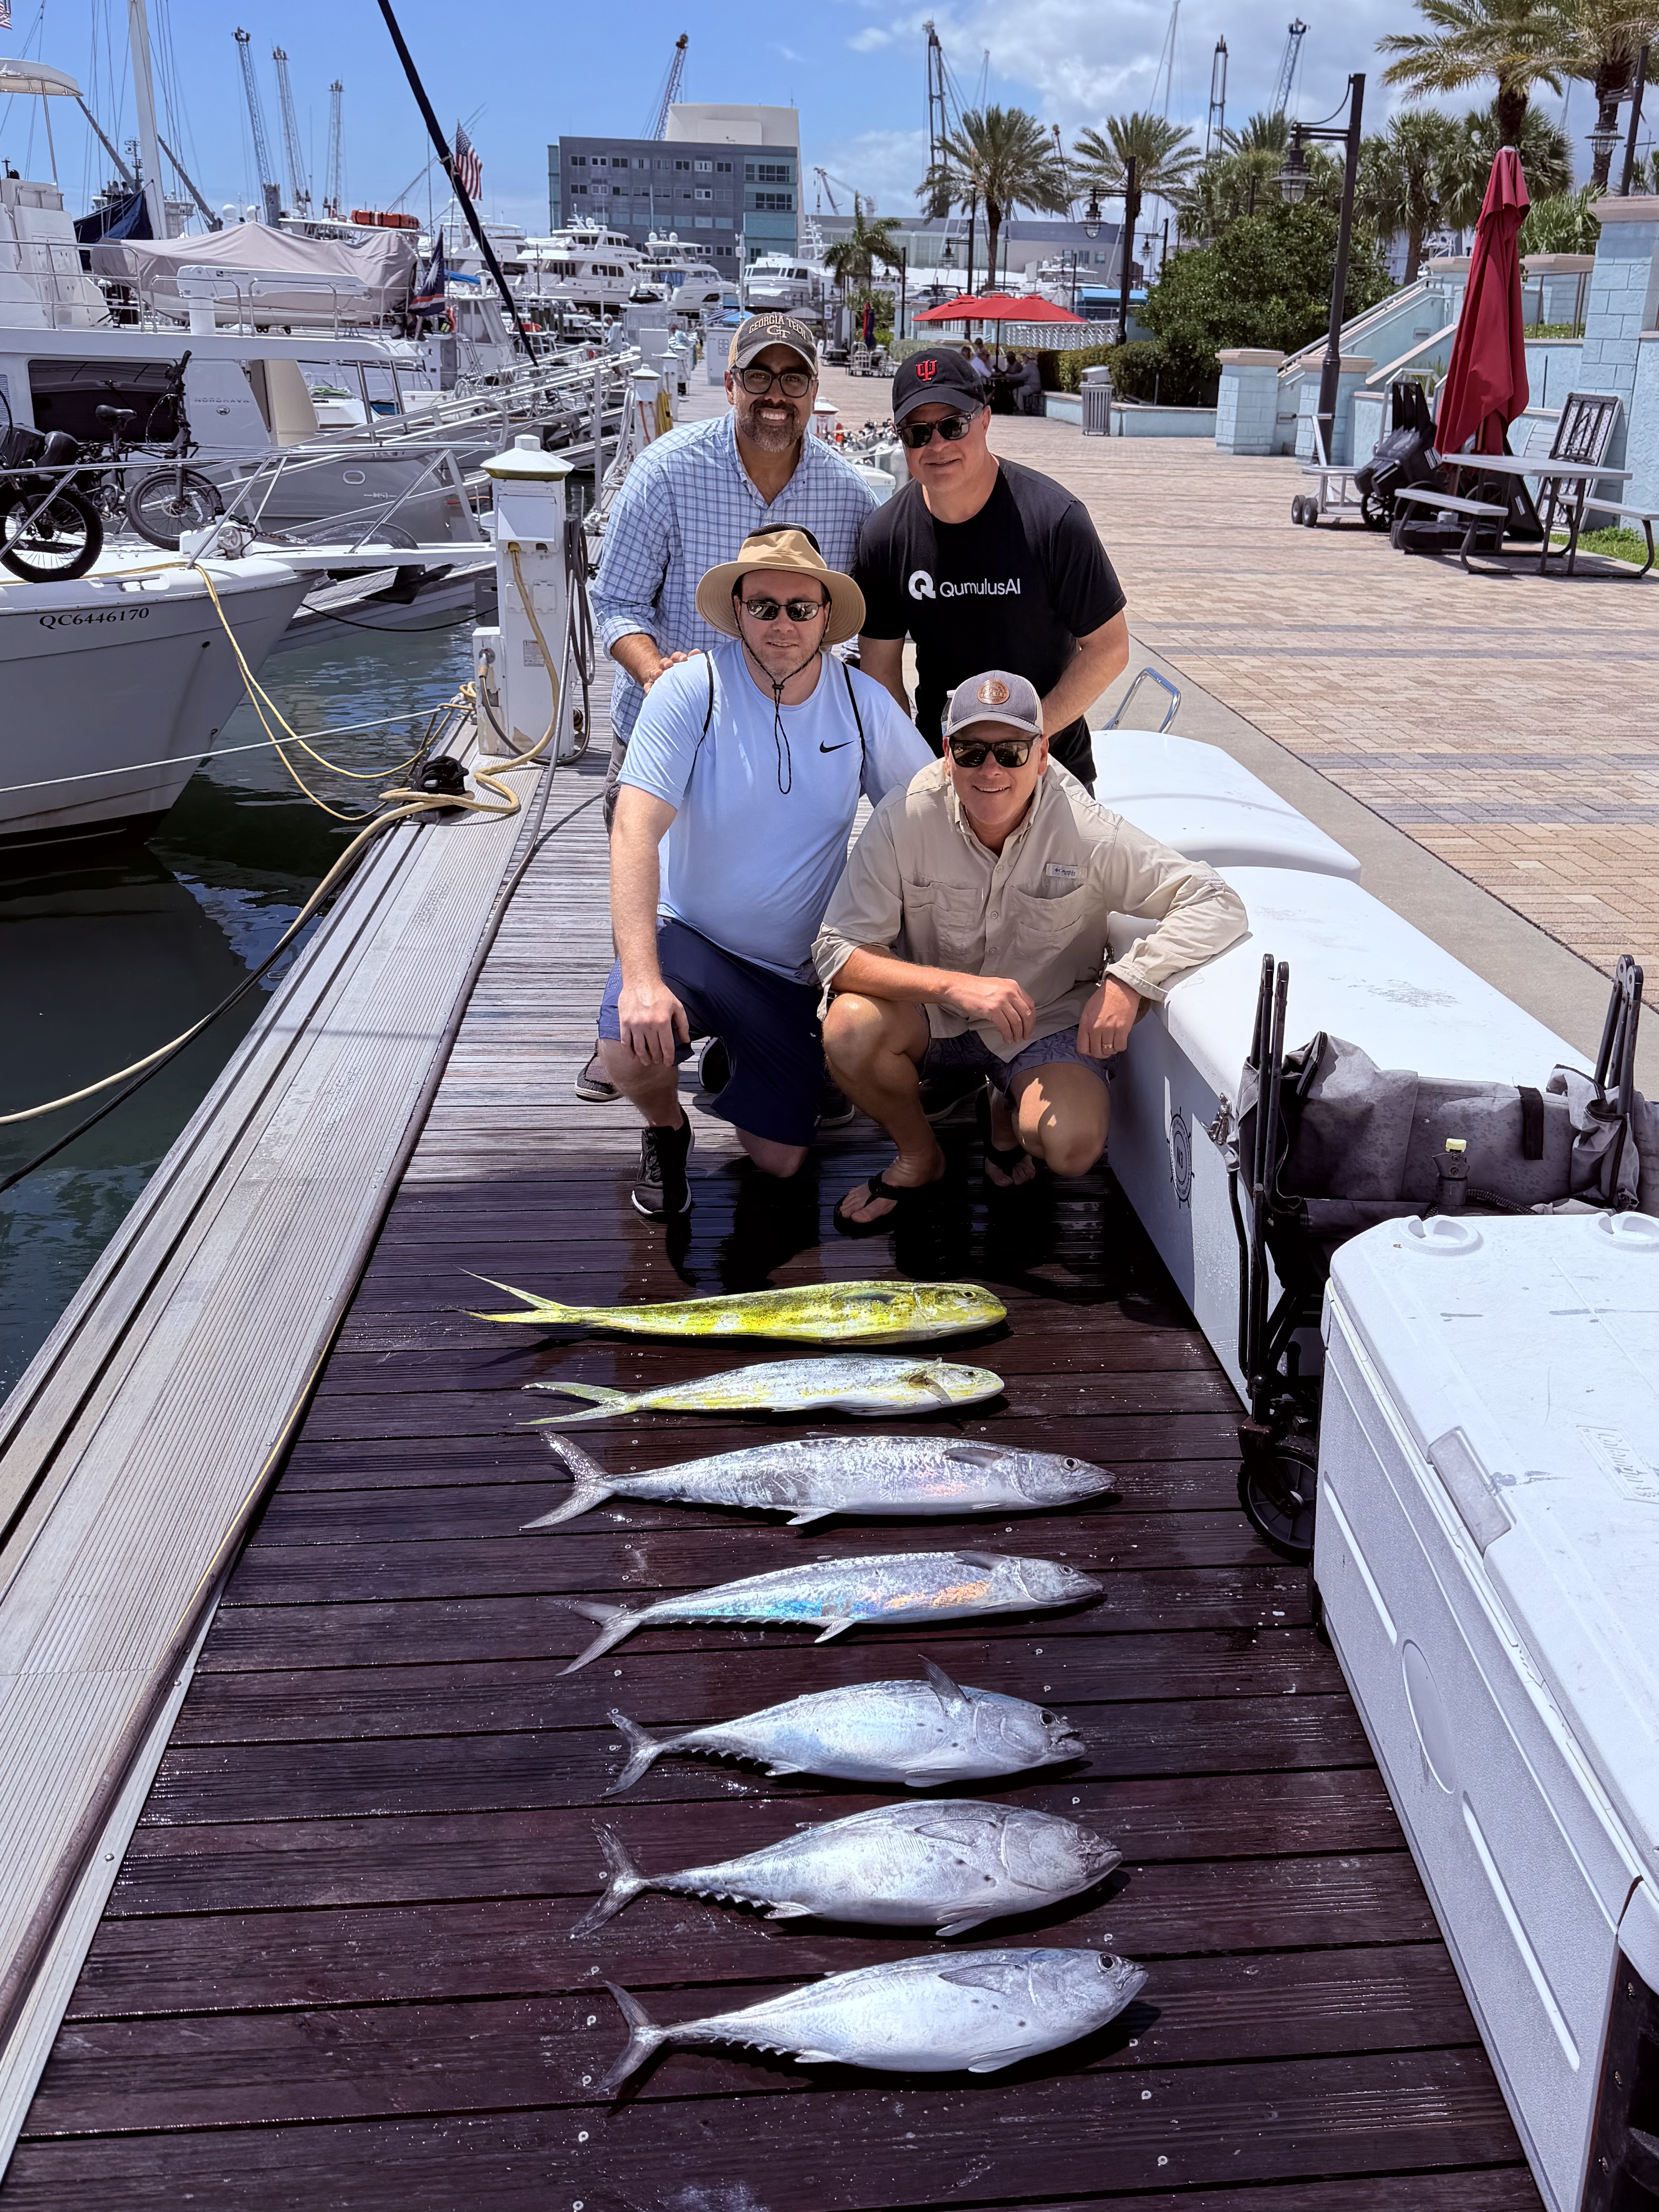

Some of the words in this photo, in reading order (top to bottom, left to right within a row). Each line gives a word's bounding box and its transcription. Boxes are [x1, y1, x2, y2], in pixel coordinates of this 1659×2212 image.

[749, 315, 785, 334] GEORGIA
[786, 317, 806, 340] TECH
[940, 578, 1021, 598] QumulusAI
[39, 607, 150, 630] QC6446170
